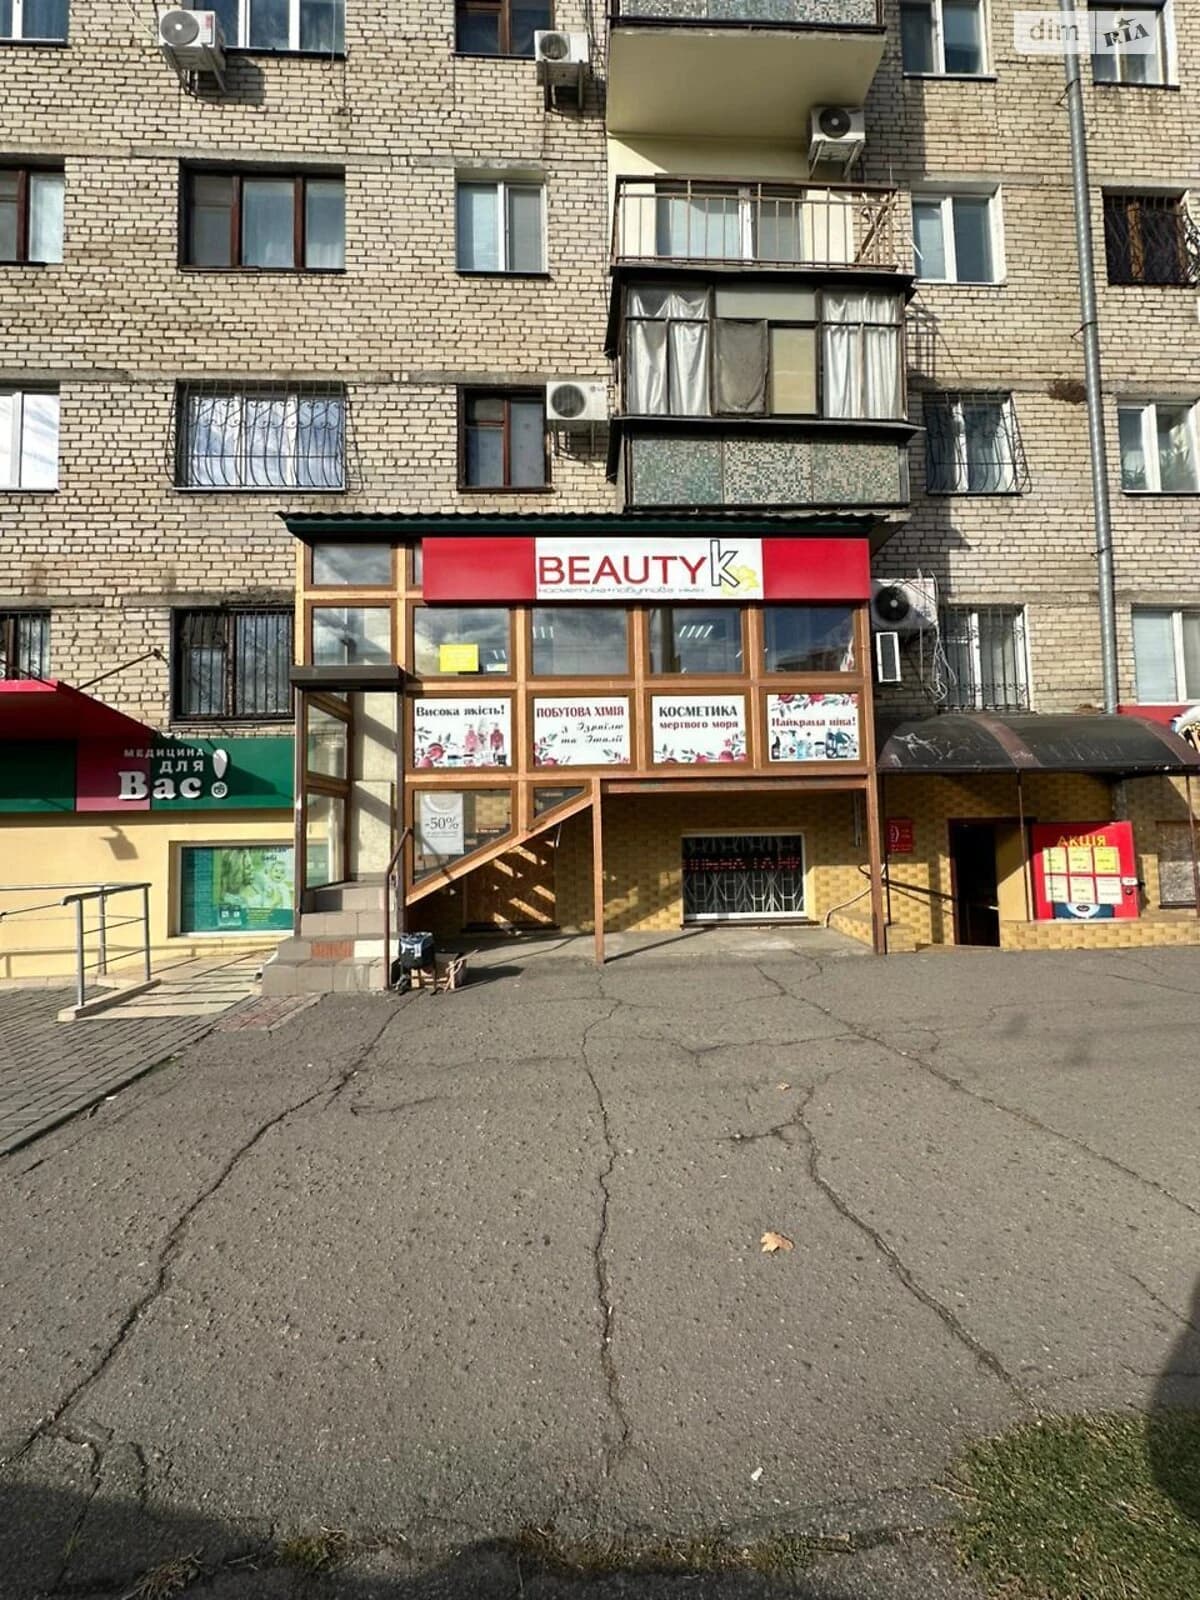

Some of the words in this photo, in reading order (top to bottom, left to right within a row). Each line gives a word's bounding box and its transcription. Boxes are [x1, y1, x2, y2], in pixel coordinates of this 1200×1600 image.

[416, 706, 460, 717] Висока
[464, 704, 505, 716] якість!
[536, 705, 592, 718] ПОБУТОВА
[594, 705, 625, 717] ХІМІЯ
[659, 705, 738, 717] КОСМЕТИКА
[659, 719, 708, 730] мертвого
[712, 719, 739, 730] моря
[771, 717, 826, 728] Найкраща
[123, 748, 205, 759] МЕДИЦИНА
[160, 760, 205, 774] ДЛЯ
[424, 816, 459, 830] -50%
